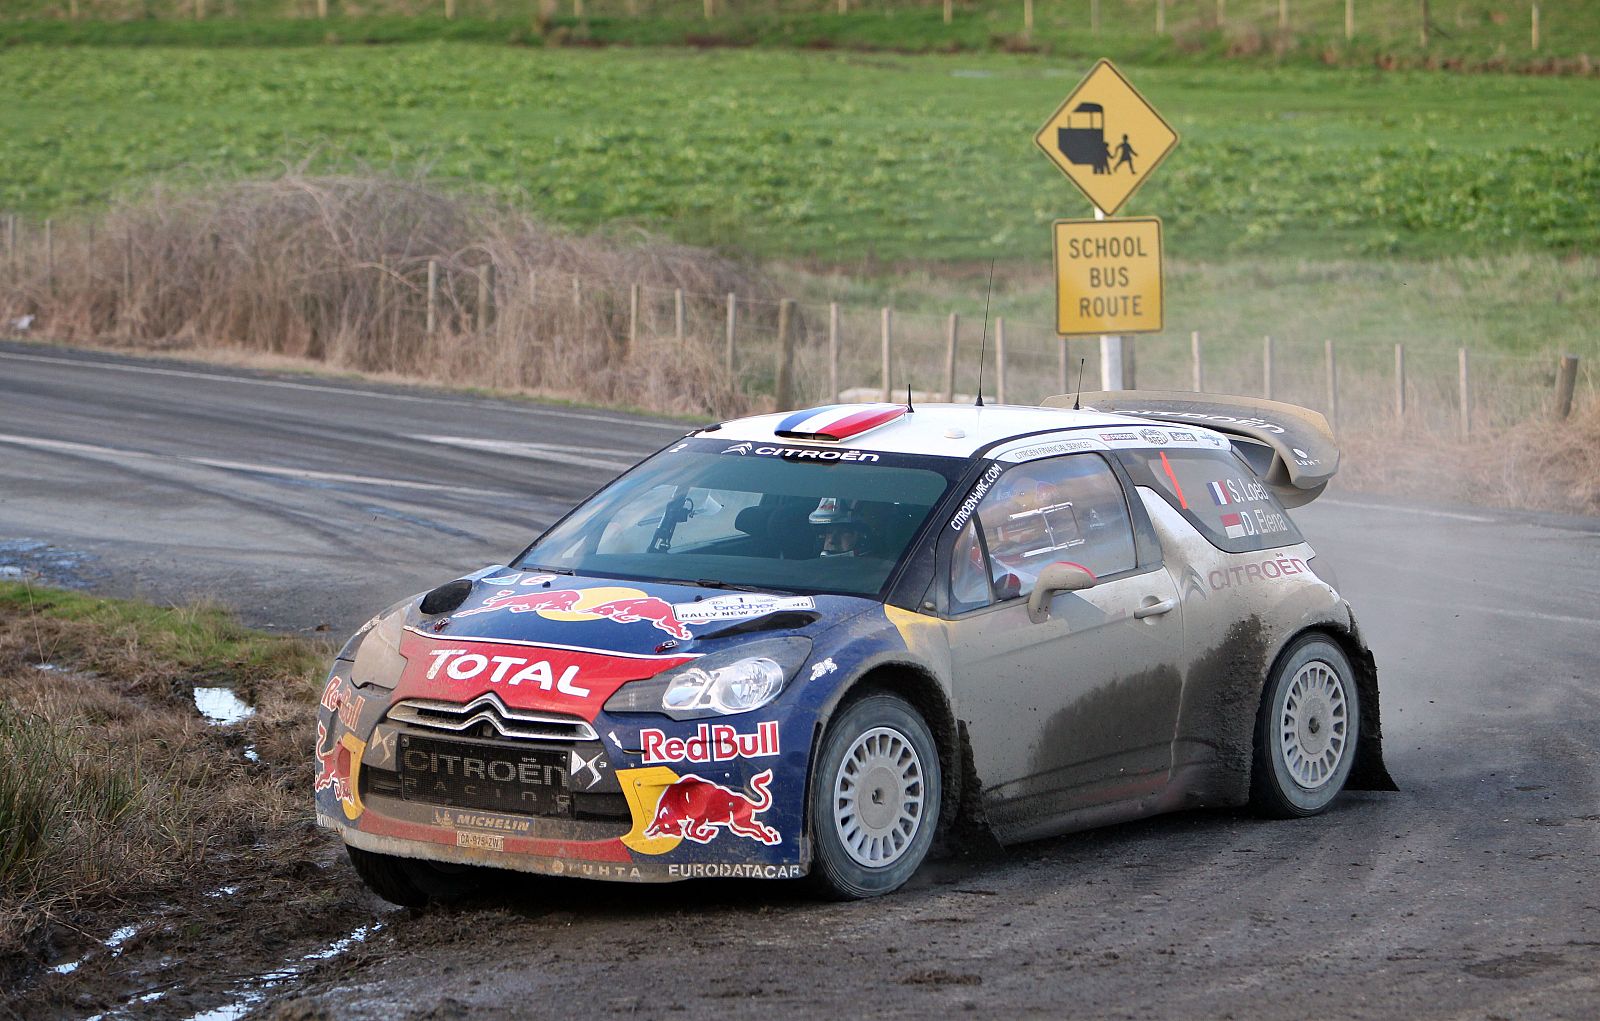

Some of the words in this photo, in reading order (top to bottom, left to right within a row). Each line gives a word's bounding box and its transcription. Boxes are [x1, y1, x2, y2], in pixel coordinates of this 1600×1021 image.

[1069, 236, 1148, 259] SCHOOL
[1090, 267, 1129, 288] BUS
[1079, 295, 1142, 318] ROUTE
[950, 462, 1003, 531] CITROEN-WRC.COM
[1227, 478, 1245, 503] S.
[1238, 477, 1269, 501] Loeb
[1240, 511, 1259, 536] D.
[1254, 508, 1288, 534] Elena
[714, 602, 775, 610] brother
[426, 649, 590, 698] TOTAL
[457, 814, 530, 832] MICHELIN
